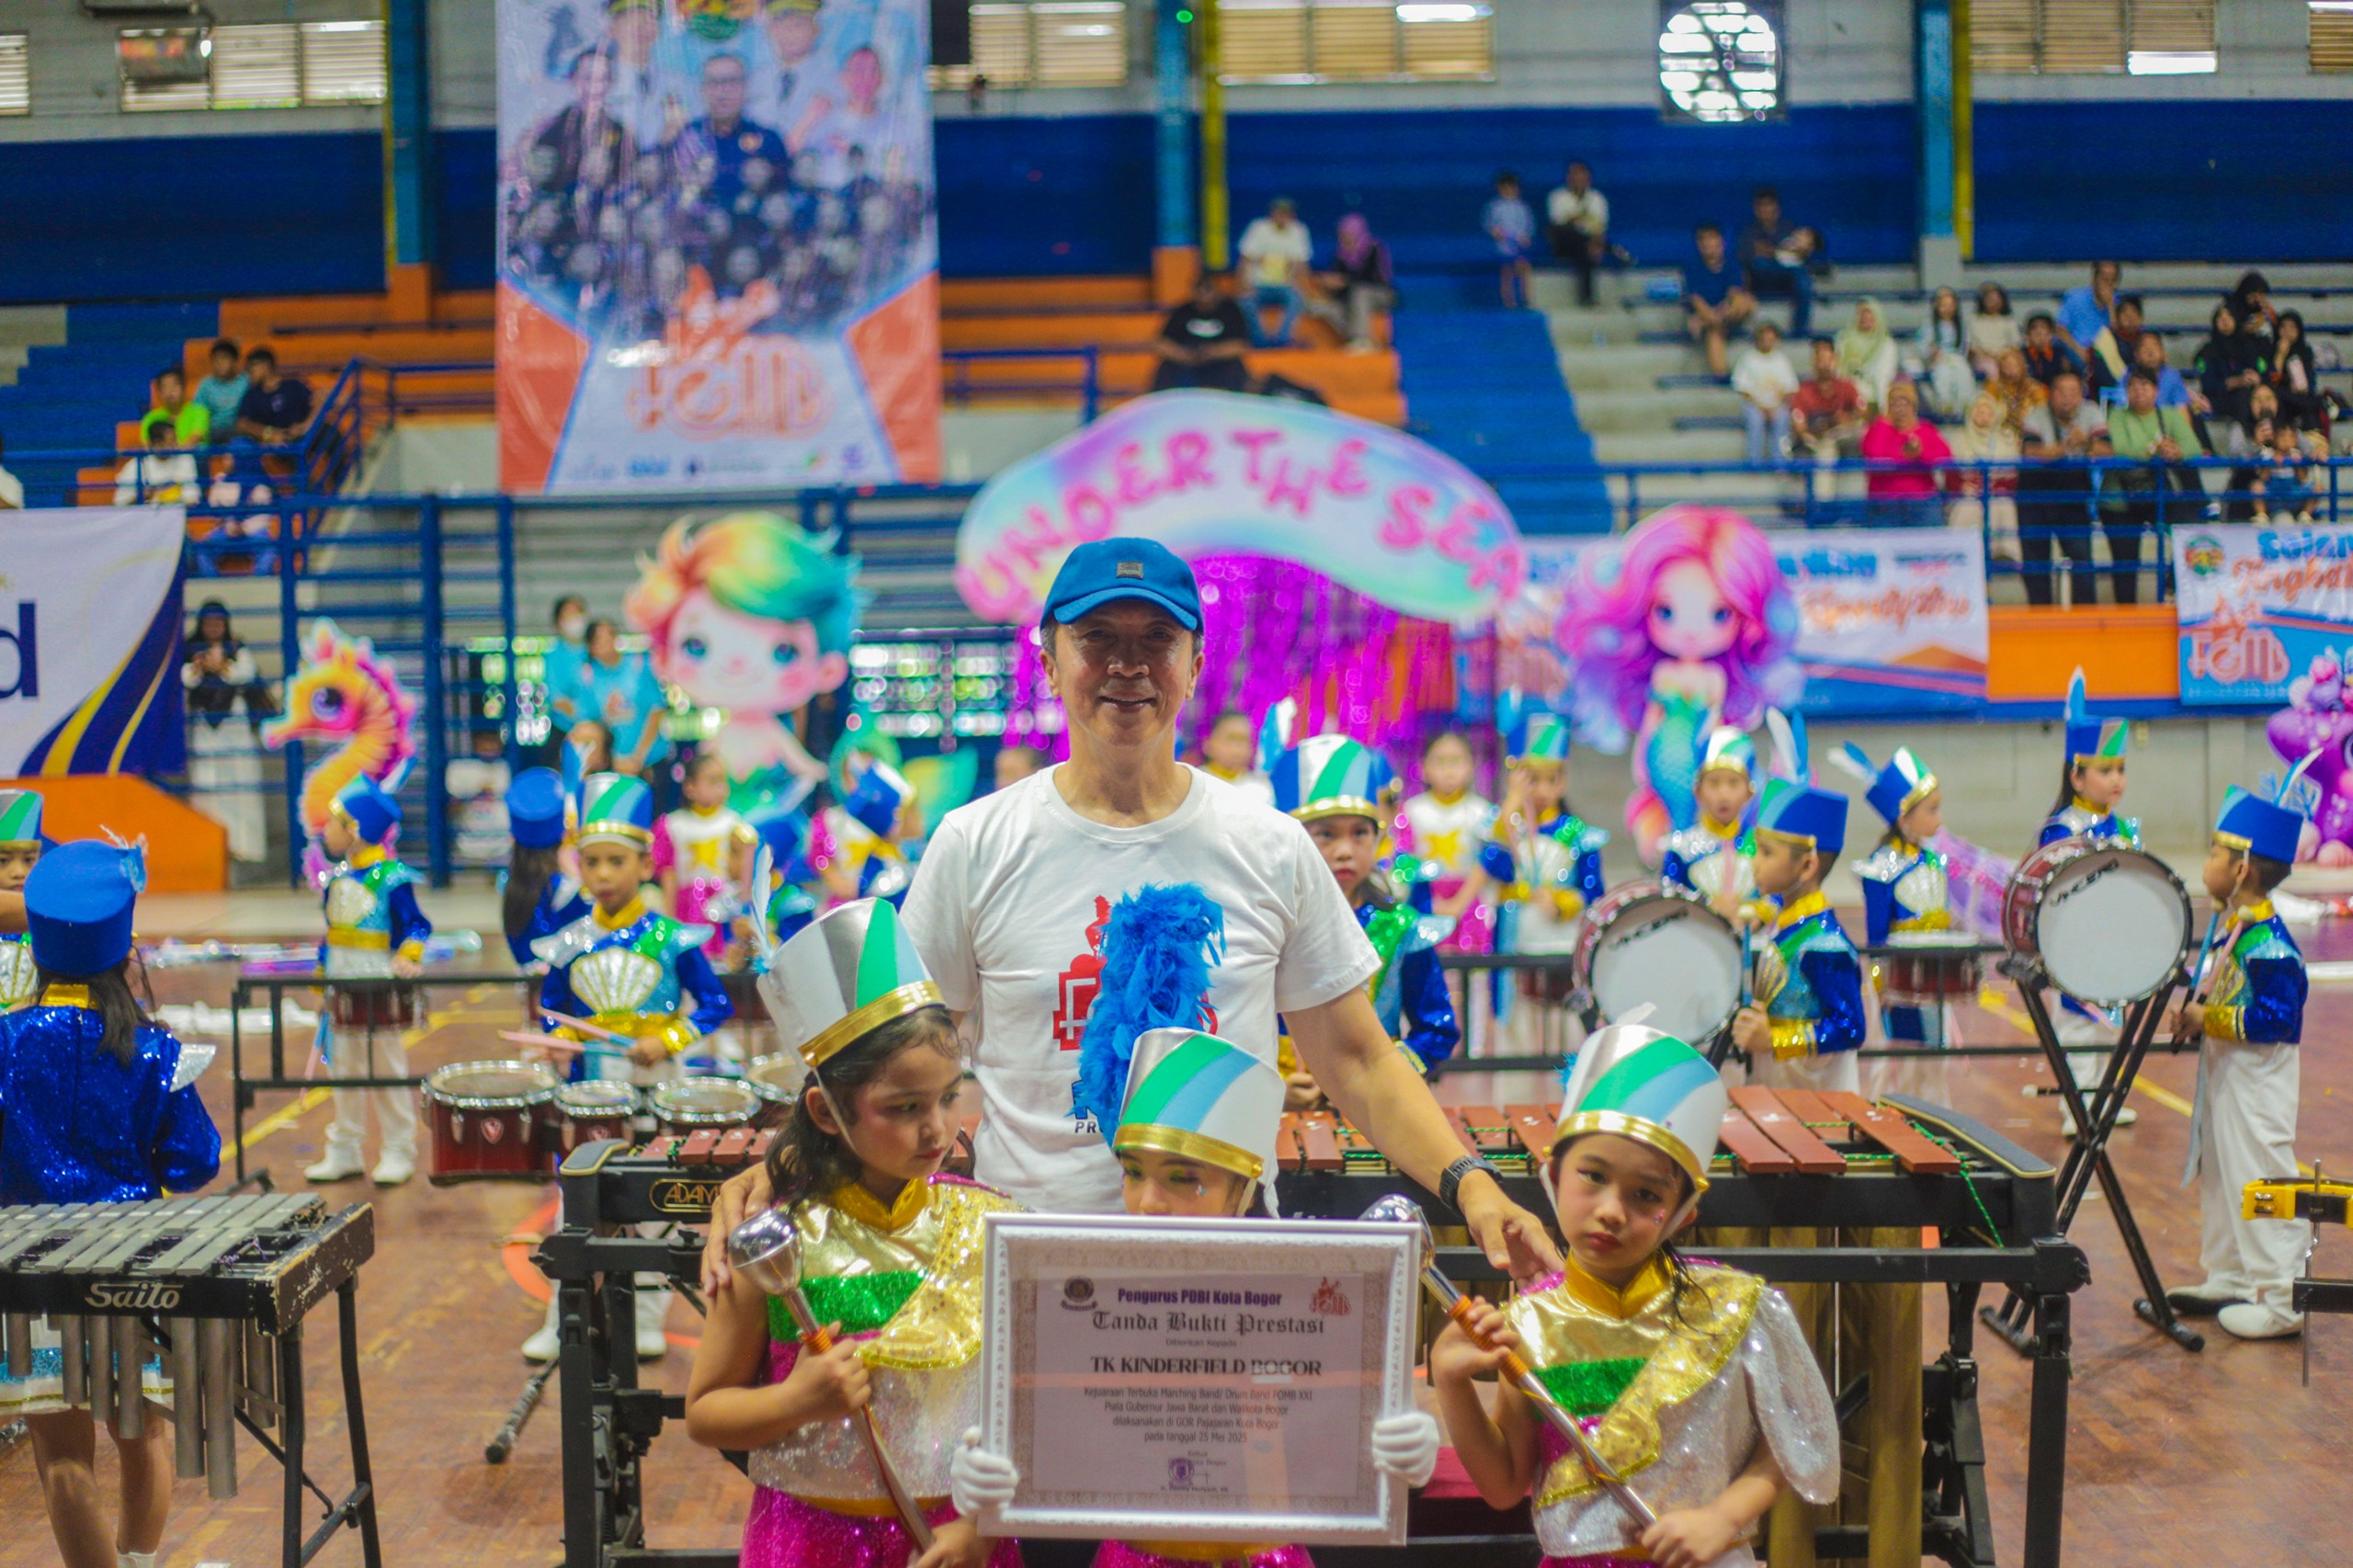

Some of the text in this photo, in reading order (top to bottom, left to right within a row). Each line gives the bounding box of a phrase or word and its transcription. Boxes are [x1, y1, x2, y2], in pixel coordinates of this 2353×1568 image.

[953, 429, 1524, 623] UNDER THE SEA
[664, 1183, 722, 1204] ADAM
[85, 1280, 183, 1308] Saito
[1118, 1289, 1282, 1307] Pengurus PDBI Kota Bogor
[1092, 1311, 1324, 1335] Tanda Bukti Prestasi
[1091, 1357, 1323, 1376] TK KINDERFIELD BOGOR
[1084, 1388, 1124, 1399] Kejuaraan
[1127, 1388, 1158, 1398] Terbuka
[1161, 1389, 1197, 1400] Marching
[1226, 1390, 1247, 1400] Drum
[1250, 1390, 1271, 1400] Band
[1273, 1391, 1296, 1401] FOMB
[1299, 1391, 1313, 1401] XXI
[1105, 1402, 1289, 1415] Piala Gubernur Jawa Barat dan Walikota Bogor
[1113, 1416, 1279, 1431] dilaksanakan di GOR Pajajaran Kota Bogor
[1144, 1433, 1247, 1444] pada tanggal 25 Mei 2025
